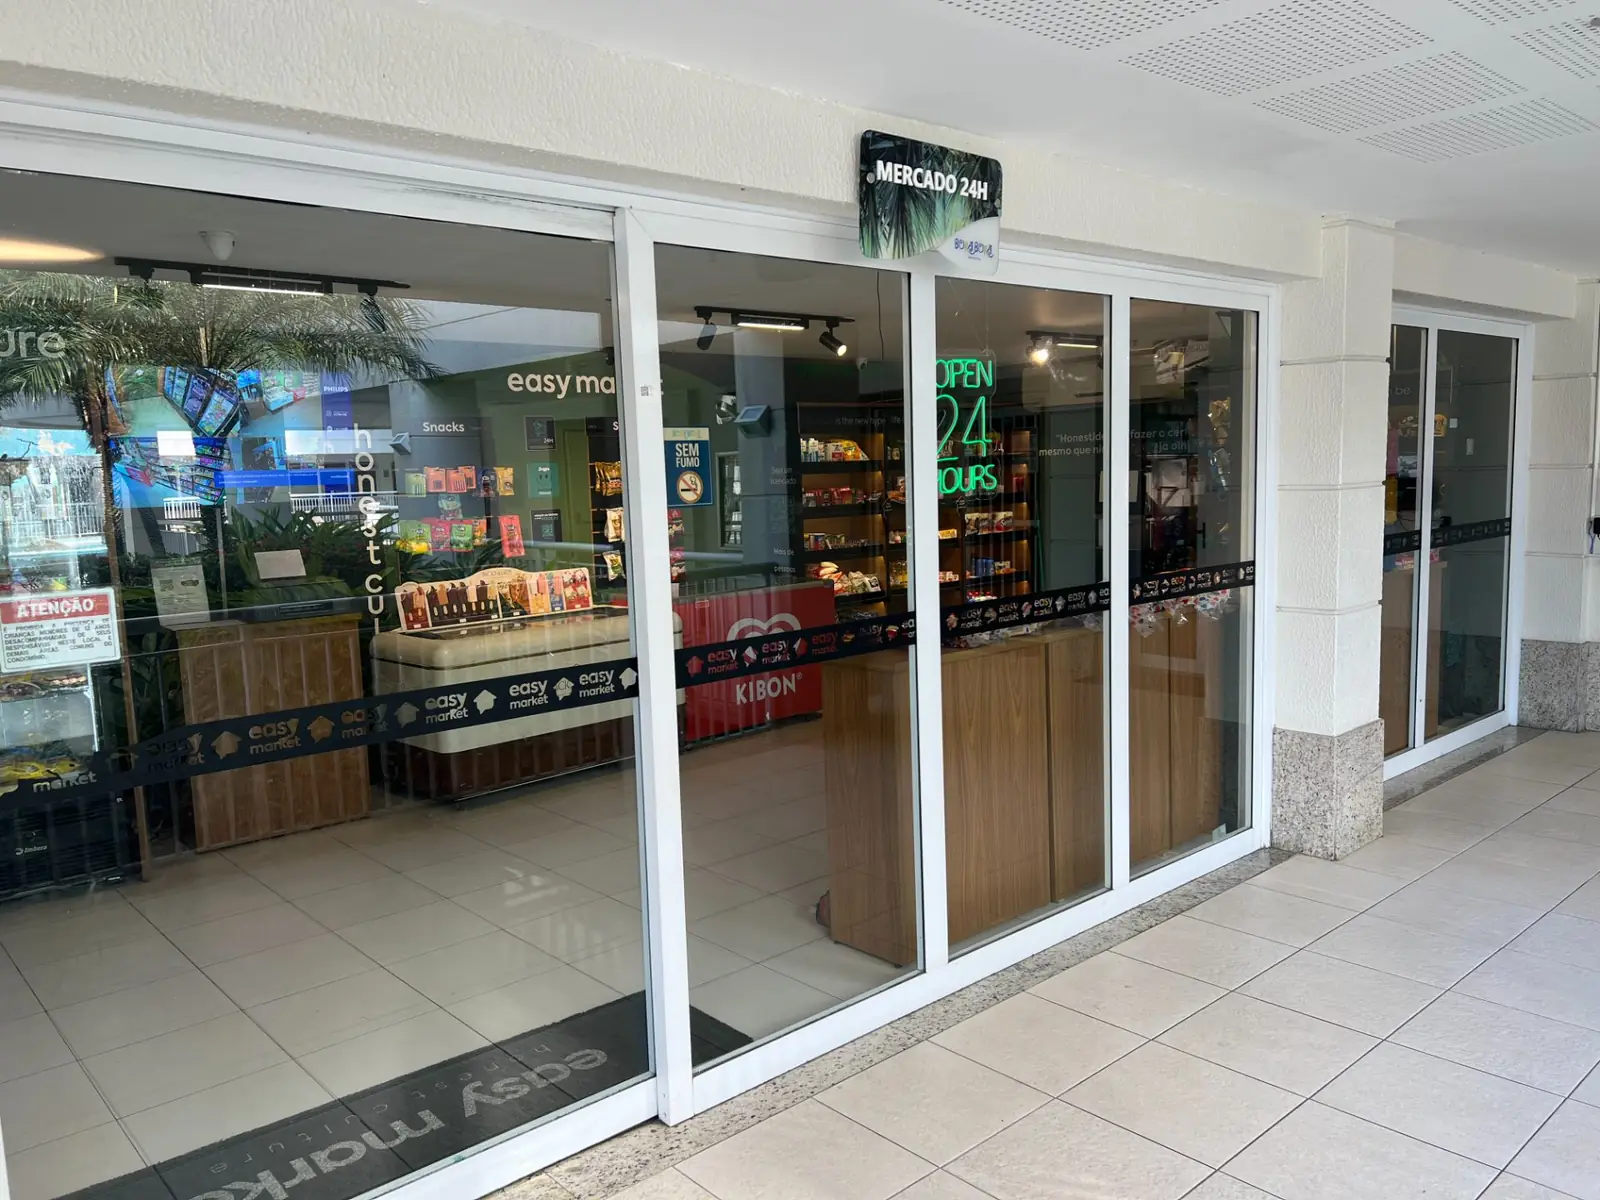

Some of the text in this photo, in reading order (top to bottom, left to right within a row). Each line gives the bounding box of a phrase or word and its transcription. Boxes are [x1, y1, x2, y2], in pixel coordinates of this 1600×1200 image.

[876, 160, 988, 200] MERCADO 24H
[936, 359, 993, 388] OPEN
[507, 372, 571, 398] easy
[423, 421, 465, 432] Snacks
[936, 394, 992, 462] 24
[1130, 428, 1156, 438] fazer
[675, 443, 700, 457] SEM
[1039, 447, 1072, 456] mesmo
[1073, 447, 1090, 456] que
[676, 457, 700, 468] FUMO
[1034, 597, 1053, 608] easy
[1068, 591, 1086, 602] easy
[17, 597, 94, 618] ATENÇÃO
[707, 648, 738, 662] easy
[762, 640, 789, 654] easy
[762, 652, 791, 665] market
[708, 660, 738, 675] market
[579, 668, 614, 686] easy
[509, 679, 548, 698] easy
[579, 682, 615, 698] market
[736, 673, 796, 705] KIBON
[425, 691, 467, 711] easy
[509, 694, 549, 710] market
[425, 708, 468, 724] market
[248, 718, 299, 740] easy
[250, 736, 302, 755] market
[33, 771, 97, 793] market
[463, 1049, 607, 1118] easy
